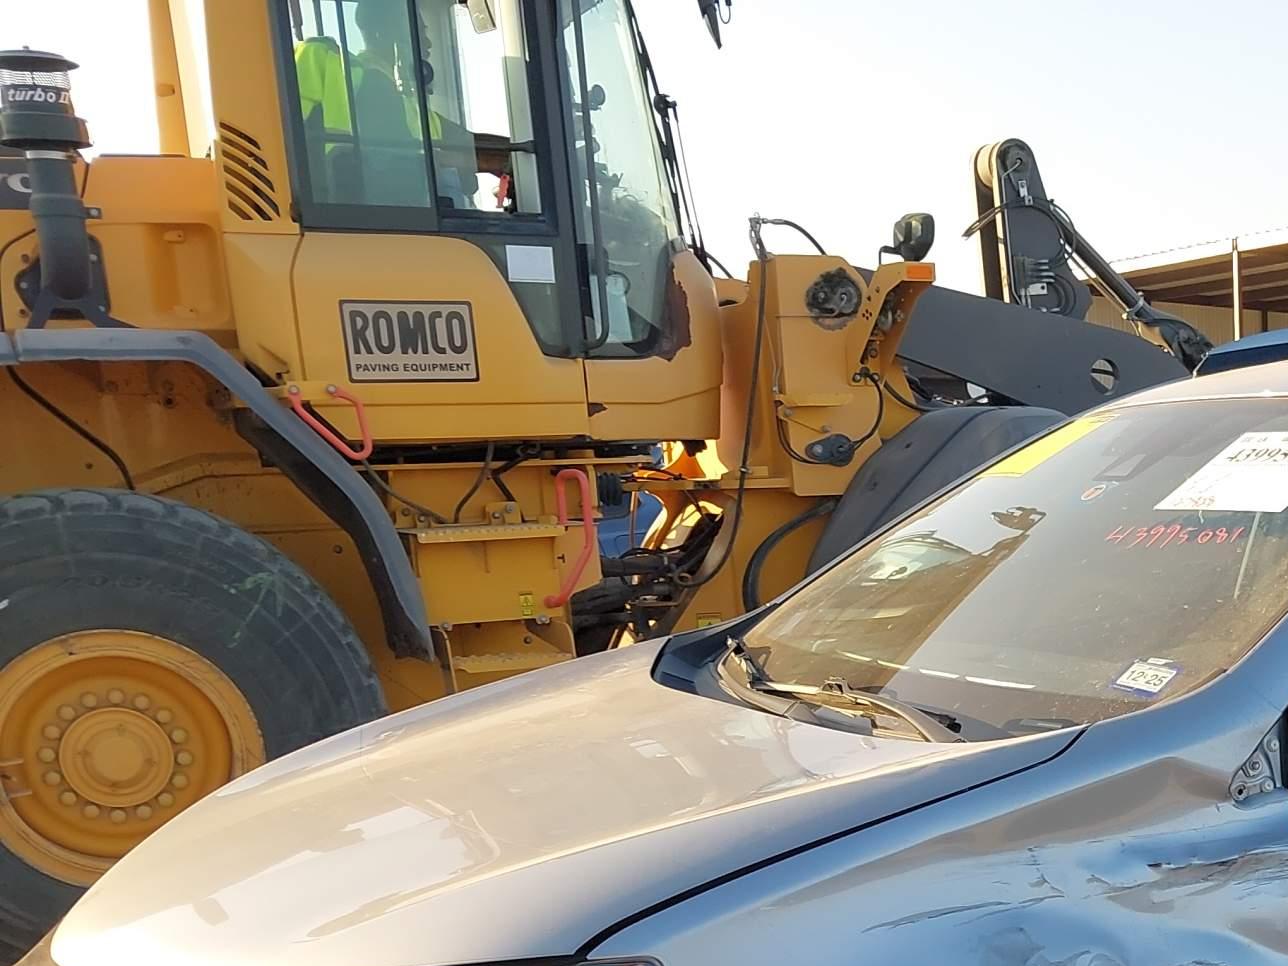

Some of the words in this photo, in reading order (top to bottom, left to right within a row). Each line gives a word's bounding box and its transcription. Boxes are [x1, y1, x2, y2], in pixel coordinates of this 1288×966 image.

[7, 87, 56, 103] turbo
[349, 310, 468, 355] ROMCO
[355, 363, 399, 373] PAVING
[403, 363, 472, 373] EQUIPMENT
[1126, 669, 1145, 682] 12
[1144, 674, 1169, 687] 25
